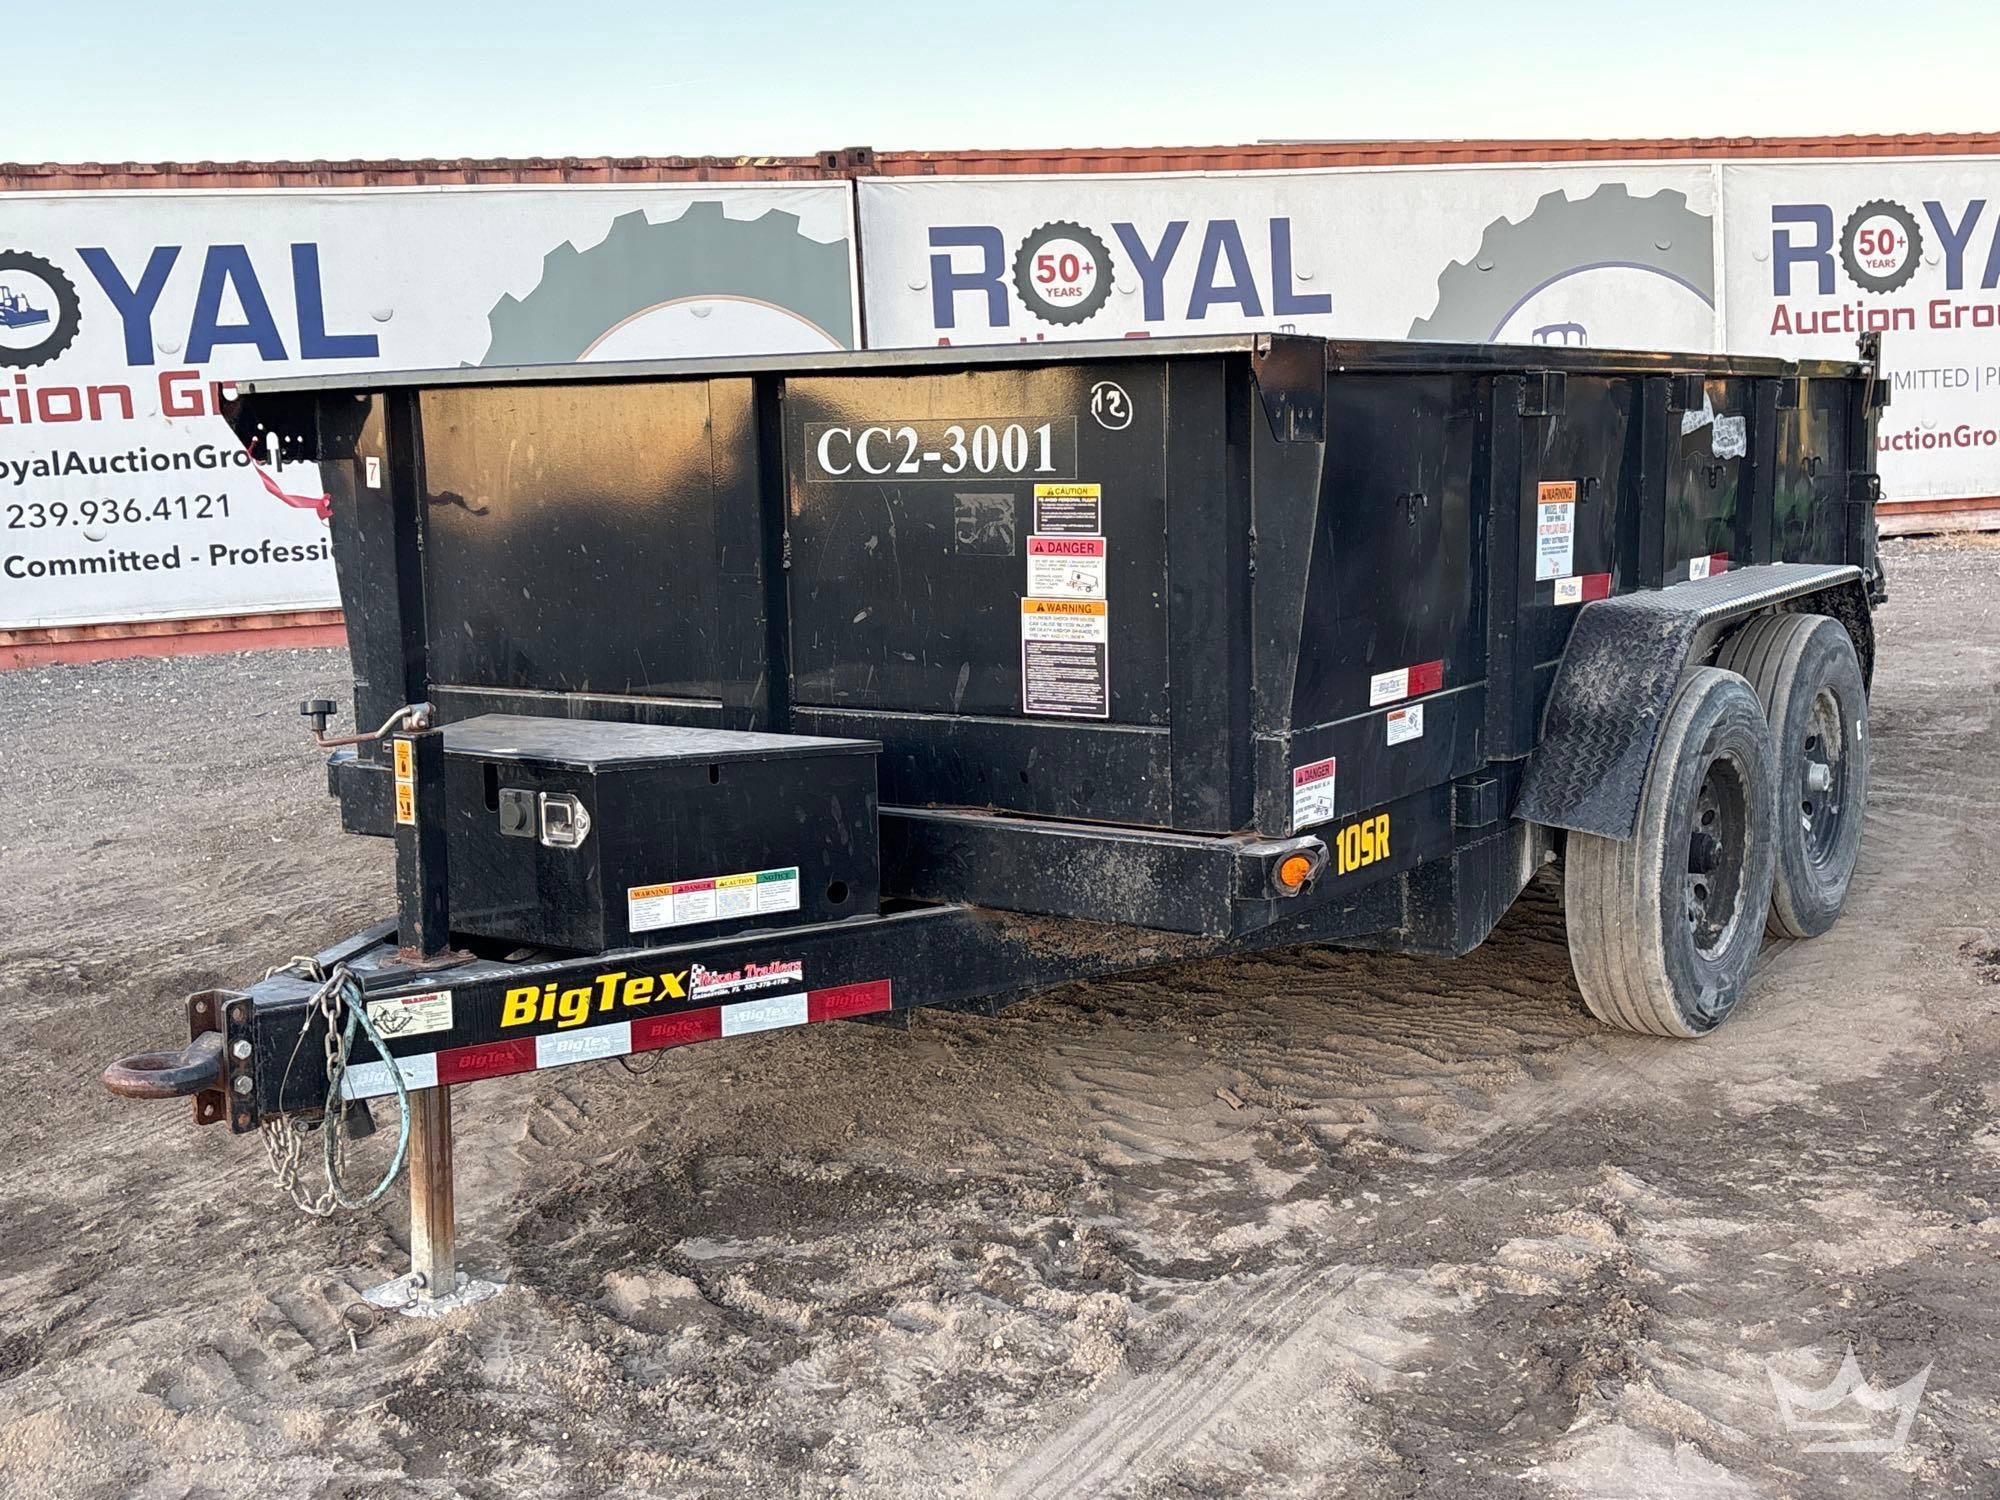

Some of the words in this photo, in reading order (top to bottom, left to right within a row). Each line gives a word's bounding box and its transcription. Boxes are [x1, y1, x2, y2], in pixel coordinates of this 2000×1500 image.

[1858, 228, 1907, 256] 50+
[928, 216, 1333, 329] ROYAL
[1035, 253, 1094, 284] 50+
[1865, 258, 1897, 270] YEARS
[1045, 286, 1083, 299] YEARS
[1770, 300, 1916, 336] Auction
[1928, 299, 2000, 330] Gro
[1886, 368, 1970, 391] MITTED
[816, 422, 1058, 476] CC2-3001
[368, 462, 378, 481] 7
[1054, 487, 1089, 495] CAUTION
[1546, 486, 1573, 501] WARNING
[5, 493, 231, 530] 239.936.4121
[1047, 541, 1095, 554] DANGER
[4, 544, 181, 580] Committed
[208, 536, 335, 567] Professi
[1046, 602, 1092, 614] WARNING
[1304, 763, 1330, 782] DANGER
[1335, 812, 1391, 876] 10SR
[633, 887, 671, 898] WARNING
[697, 970, 741, 987] Texas
[744, 959, 802, 978] Trailers
[500, 970, 690, 1028] BigTex
[825, 990, 873, 1009] BigTex
[739, 1002, 792, 1023] BigTex
[651, 1018, 705, 1038] BigTex
[556, 1035, 613, 1054] BigTex
[458, 1050, 517, 1070] BigTex
